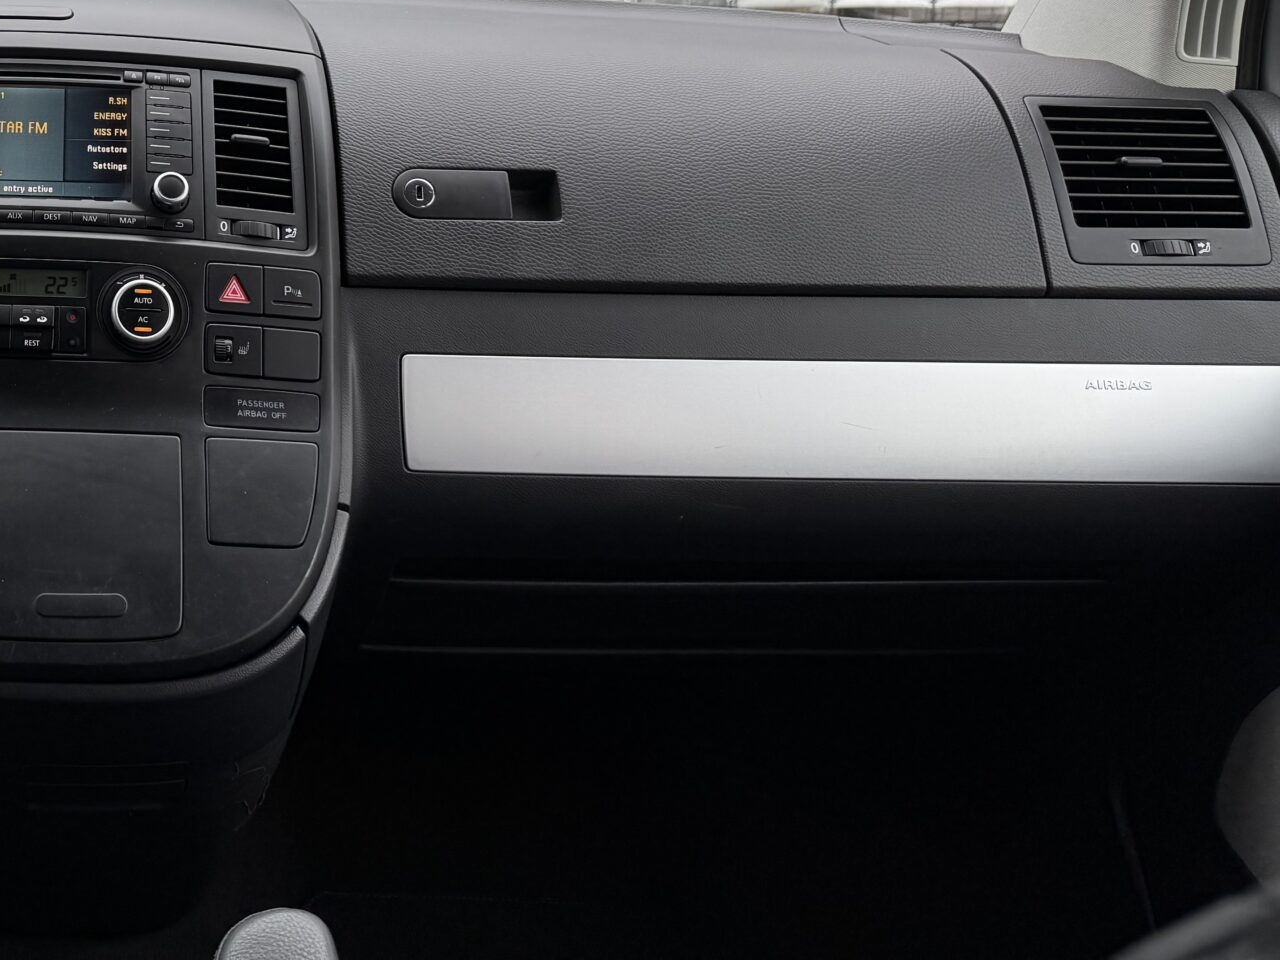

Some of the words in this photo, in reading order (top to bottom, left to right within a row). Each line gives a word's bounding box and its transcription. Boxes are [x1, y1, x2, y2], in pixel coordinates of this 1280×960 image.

[93, 112, 128, 120] ENERGY
[28, 121, 48, 134] FM
[93, 128, 111, 136] KISS
[114, 128, 128, 136] FM
[87, 144, 128, 153] Autostore
[92, 161, 128, 172] Settings
[3, 184, 26, 193] entry
[27, 184, 53, 193] active
[7, 212, 22, 220] AUX
[43, 213, 62, 221] DEST
[82, 214, 98, 223] NAV
[120, 216, 137, 225] MAP
[133, 297, 153, 305] AUTO
[24, 339, 40, 347] REST
[1084, 378, 1152, 390] AIRBAG
[237, 399, 285, 409] PASSENGER
[237, 409, 267, 419] AIRBAG
[271, 412, 287, 420] OFF
